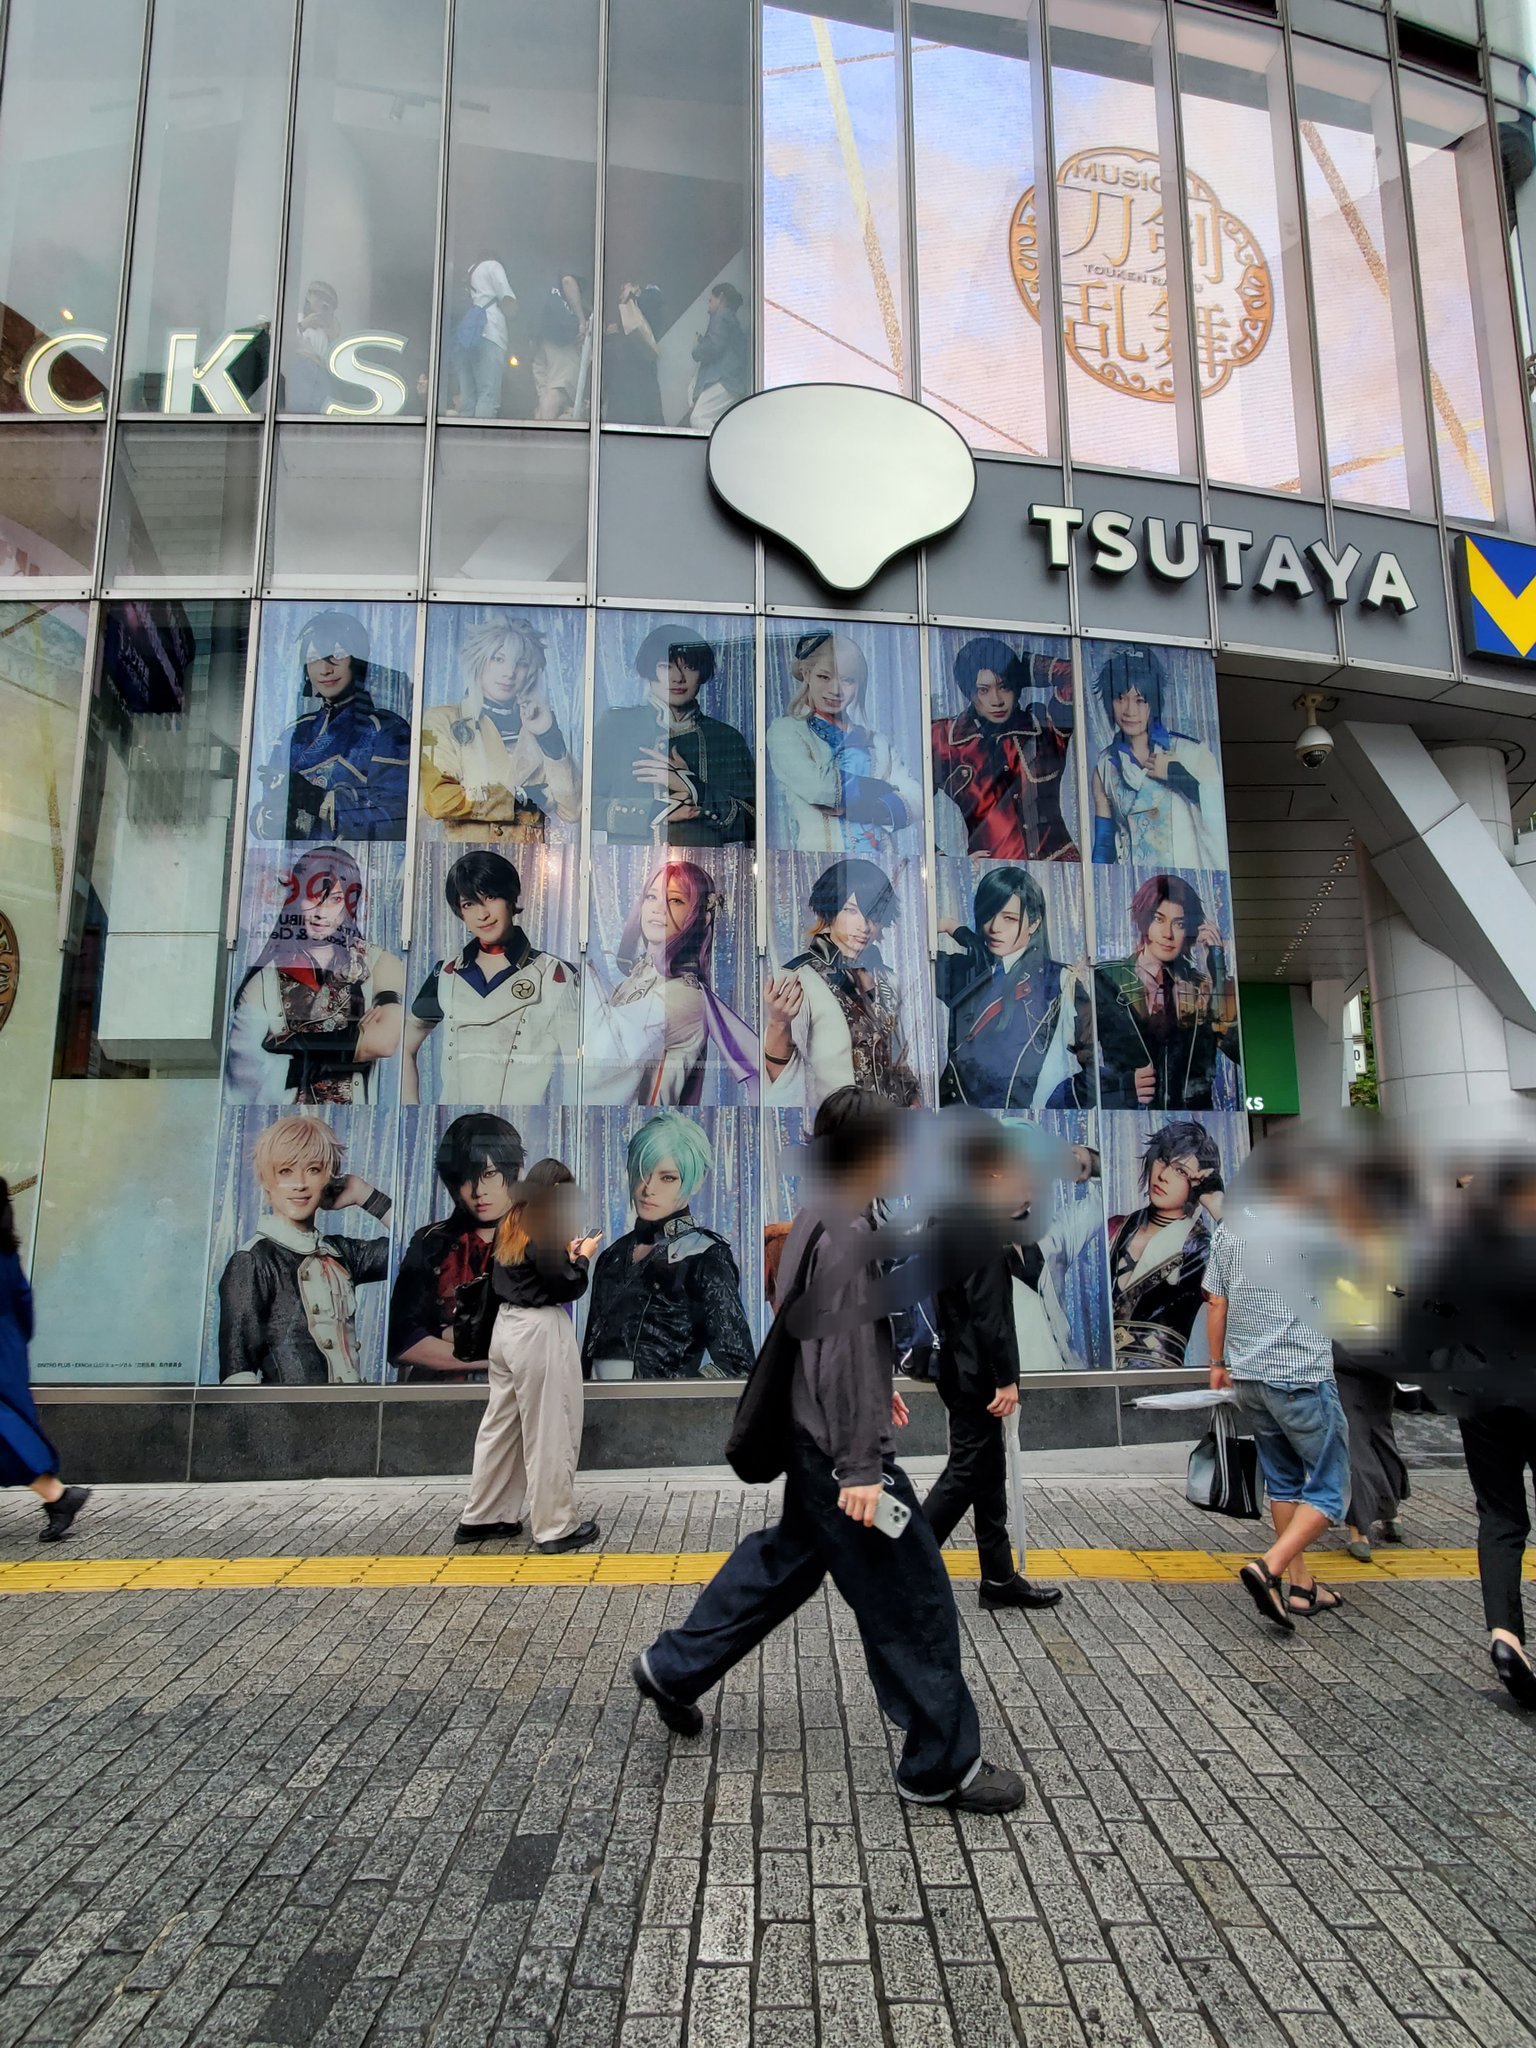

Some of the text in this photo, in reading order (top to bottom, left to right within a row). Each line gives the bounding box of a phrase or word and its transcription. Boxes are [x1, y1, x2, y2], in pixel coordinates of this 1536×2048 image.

[1071, 161, 1163, 192] MUSIC
[1083, 263, 1204, 294] TOUKEN RAU
[1028, 503, 1418, 614] TSUTAYA
